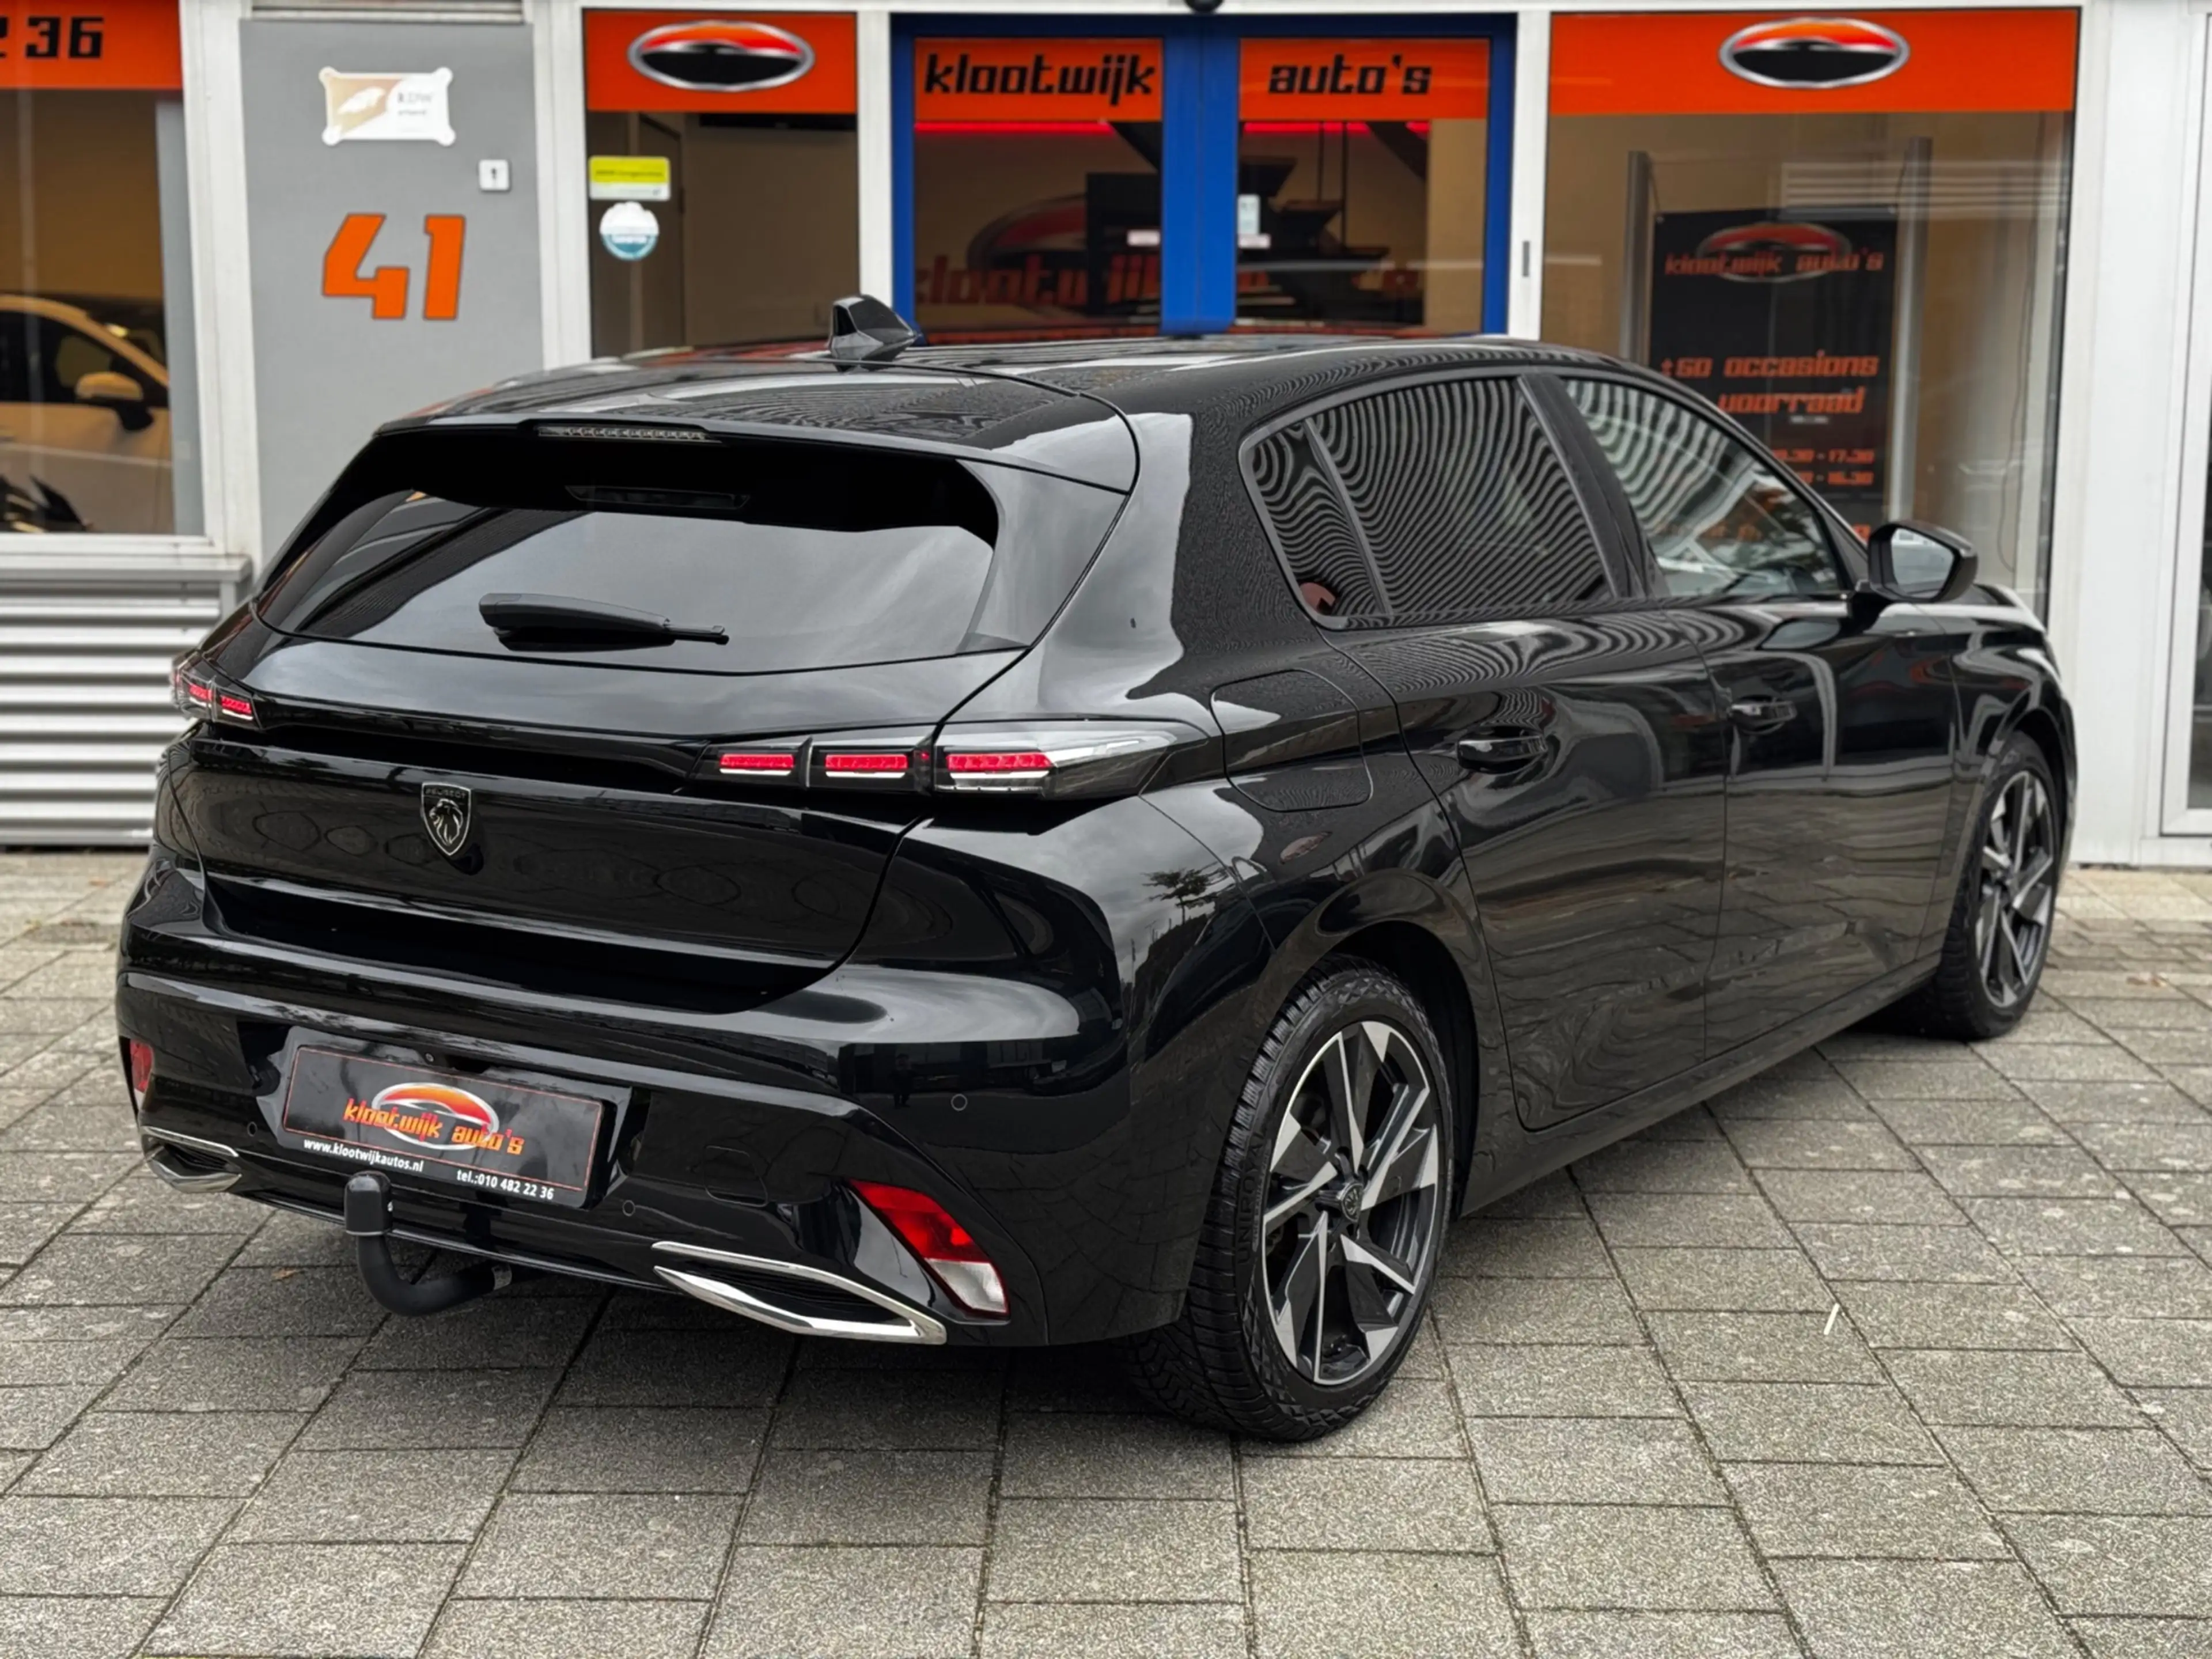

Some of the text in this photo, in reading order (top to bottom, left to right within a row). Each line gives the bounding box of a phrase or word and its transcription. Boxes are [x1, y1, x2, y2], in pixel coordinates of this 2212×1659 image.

[26, 16, 104, 58] 36
[925, 54, 1432, 107] klootwijk auto's
[323, 213, 466, 320] 41
[1723, 349, 1879, 378] occasions
[343, 1097, 525, 1155] klootwijk auto's
[304, 1139, 424, 1172] www.klootwijkautos.nl
[500, 1178, 521, 1193] 482
[523, 1183, 537, 1197] 22
[540, 1185, 555, 1200] 36
